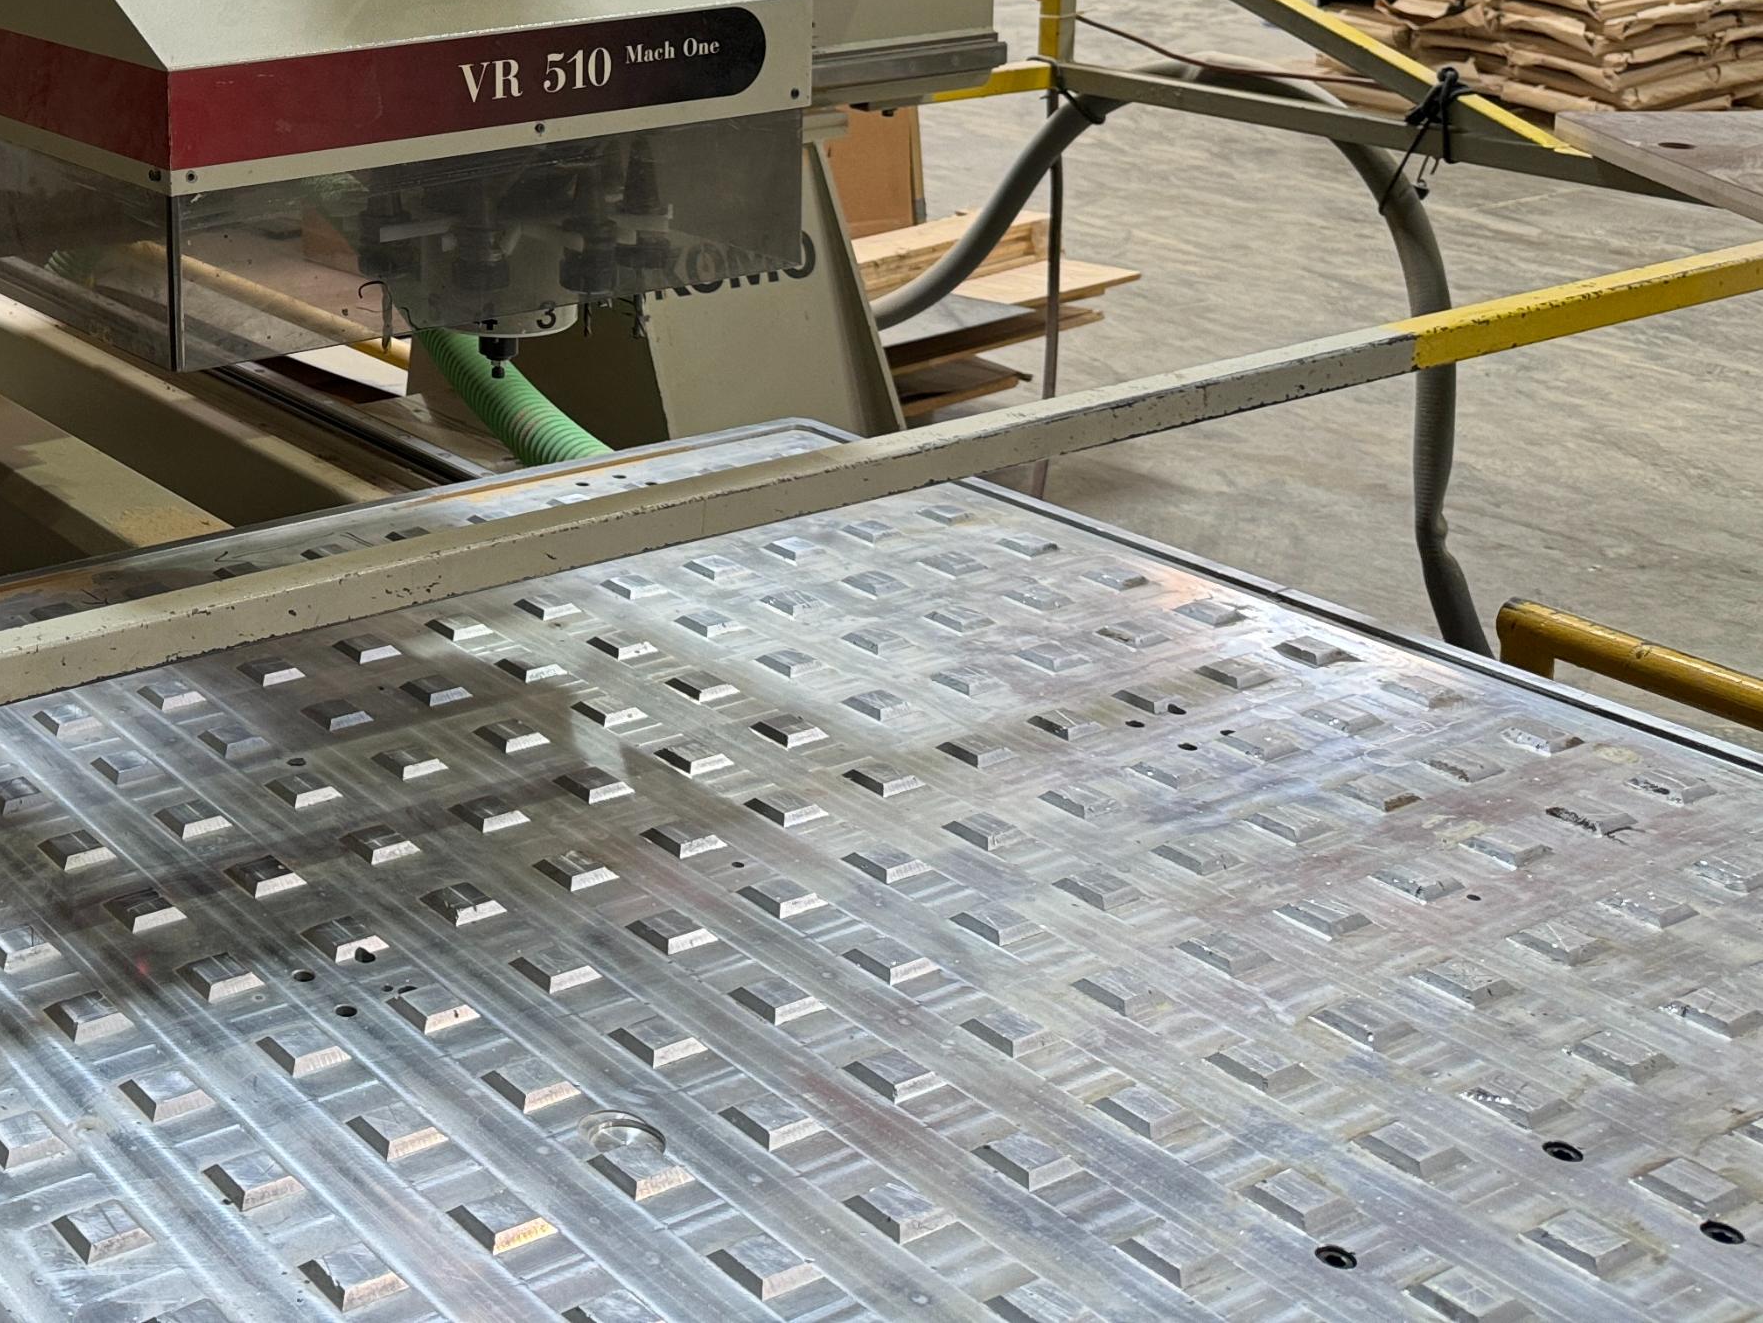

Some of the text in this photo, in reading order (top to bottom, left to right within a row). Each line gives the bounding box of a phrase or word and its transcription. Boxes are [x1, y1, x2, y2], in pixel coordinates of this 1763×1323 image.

[458, 37, 720, 102] VR 510 Mach One
[536, 301, 556, 329] 3
